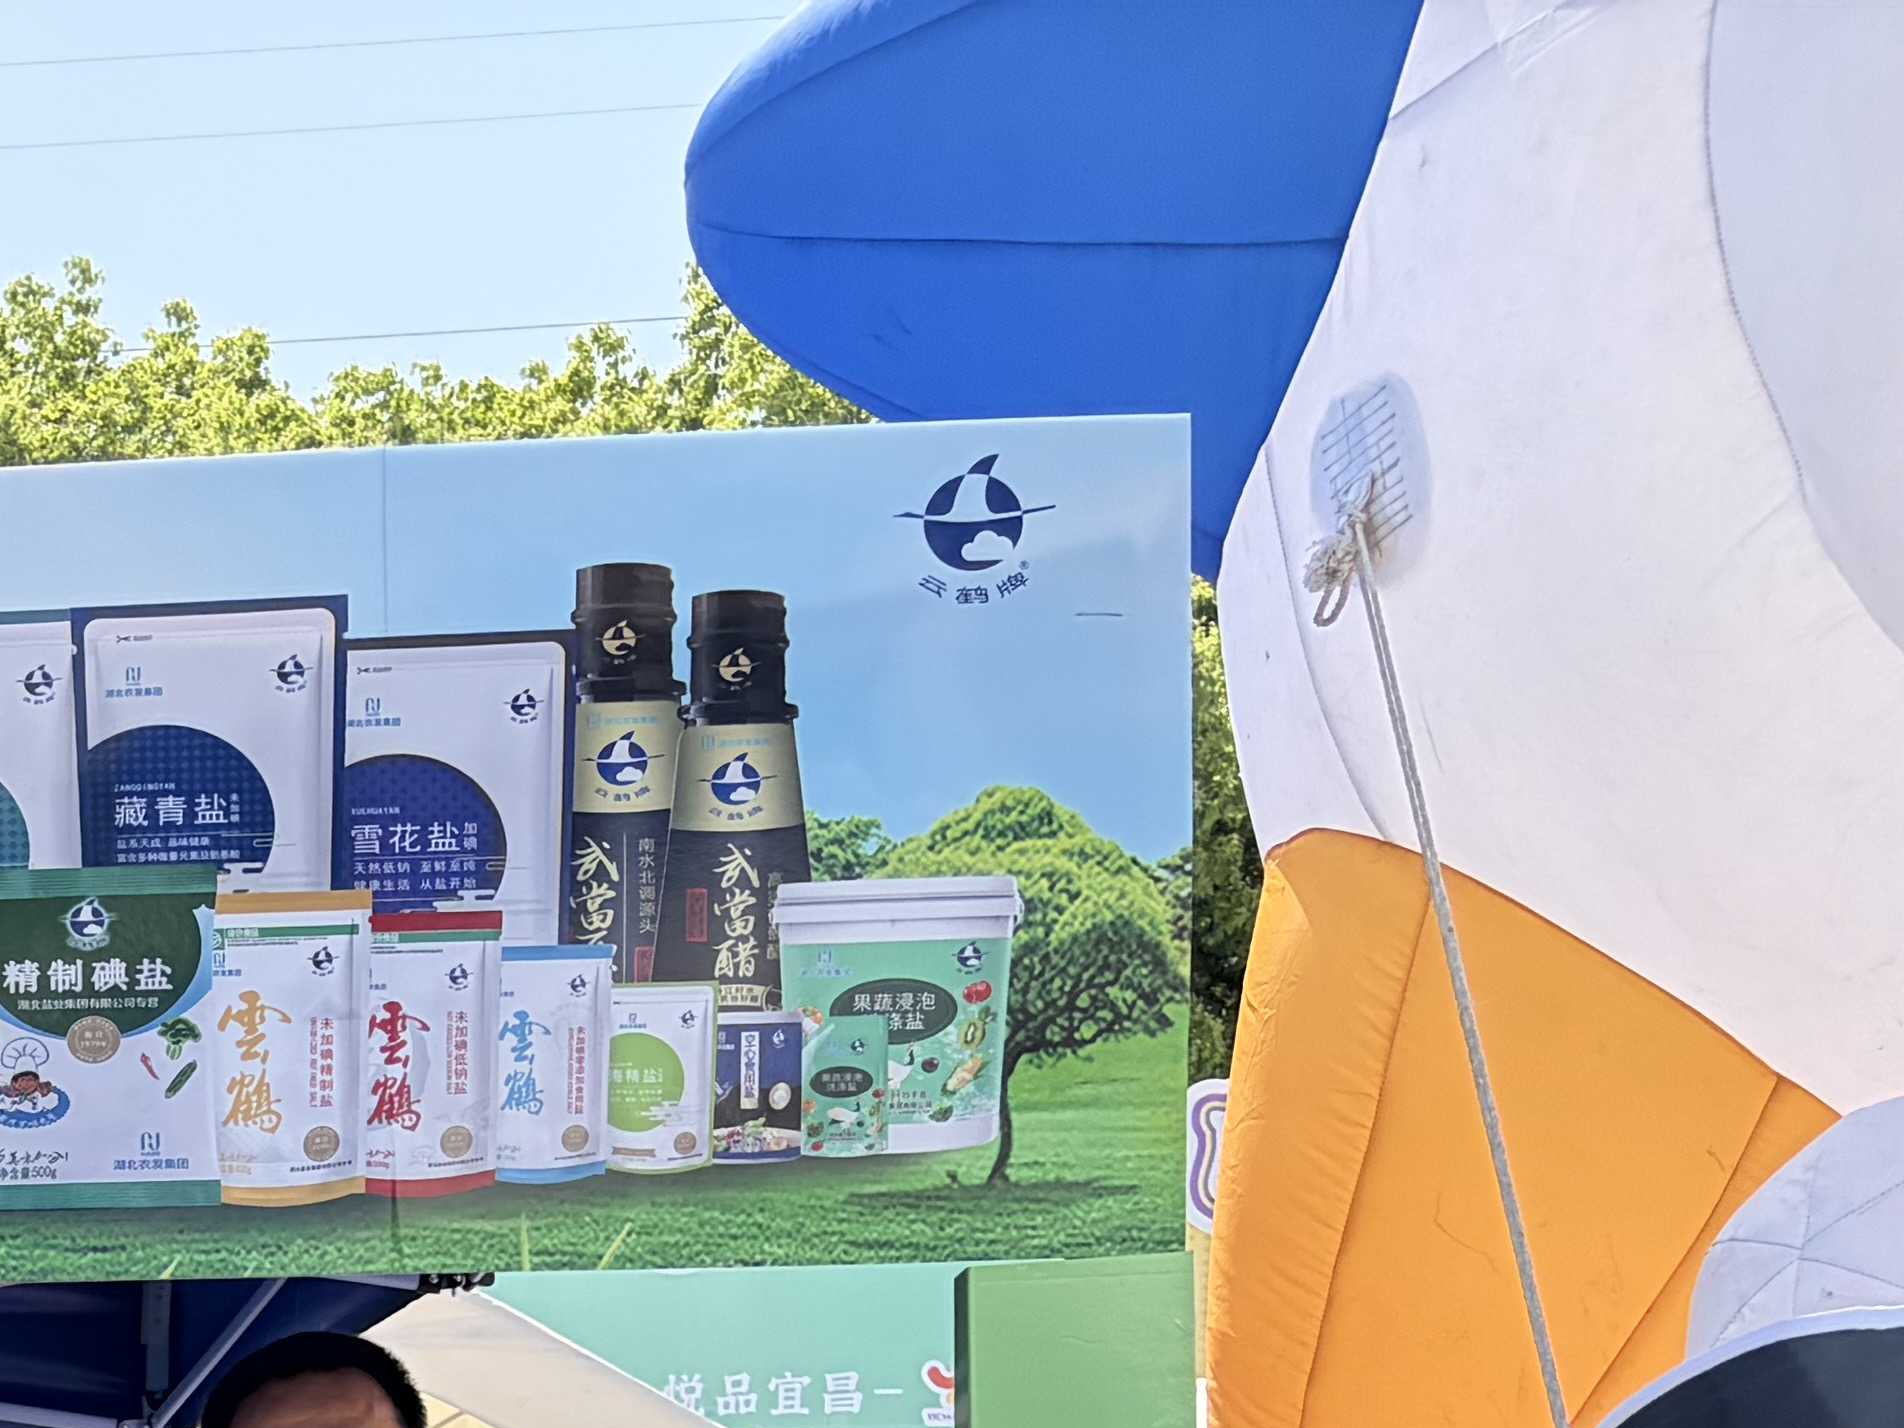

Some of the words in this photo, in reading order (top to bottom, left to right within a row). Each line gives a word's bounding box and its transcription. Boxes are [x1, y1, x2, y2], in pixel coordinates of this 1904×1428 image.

[919, 563, 1030, 606] 云鹤牌
[114, 793, 229, 828] 藏青盐
[351, 822, 460, 855] 雪花盐
[353, 862, 410, 875] 天然低钠
[420, 877, 476, 889] 从盐开始
[638, 838, 657, 934] 南水北调源头
[2, 957, 174, 995] 精制碘盐
[853, 992, 936, 1013] 果蔬浸泡
